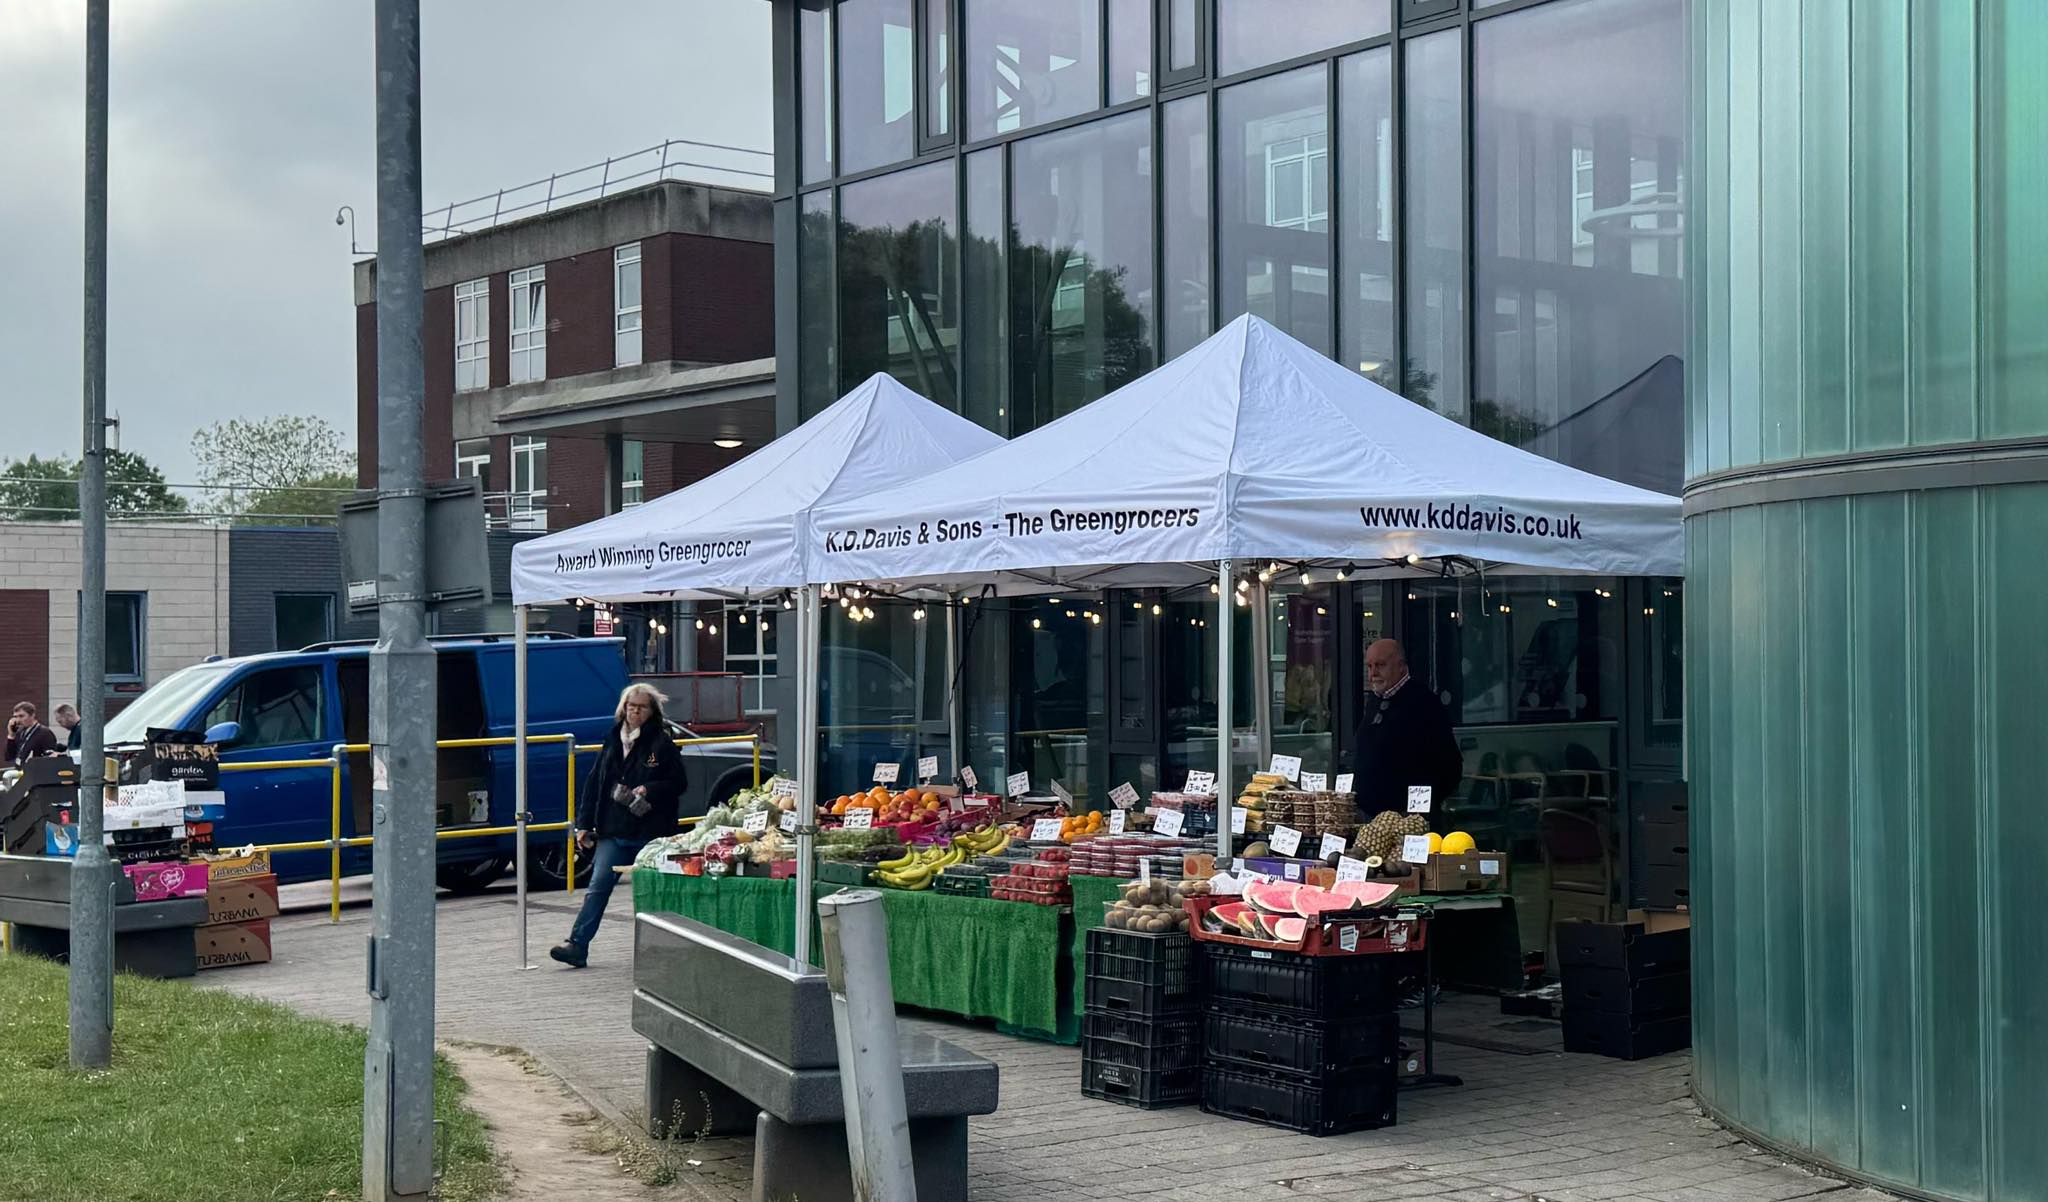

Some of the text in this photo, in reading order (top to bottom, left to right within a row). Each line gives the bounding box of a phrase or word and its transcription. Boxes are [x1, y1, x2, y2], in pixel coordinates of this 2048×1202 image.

[826, 525, 912, 554] K.D.Davis
[917, 521, 930, 545] &
[936, 519, 983, 543] Sons
[1005, 512, 1044, 538] The
[1050, 506, 1200, 536] Greengrocers
[1360, 502, 1582, 540] www.kddavis.co.uk
[555, 538, 752, 574] Award Winning Greengrocer
[171, 765, 204, 777] garden
